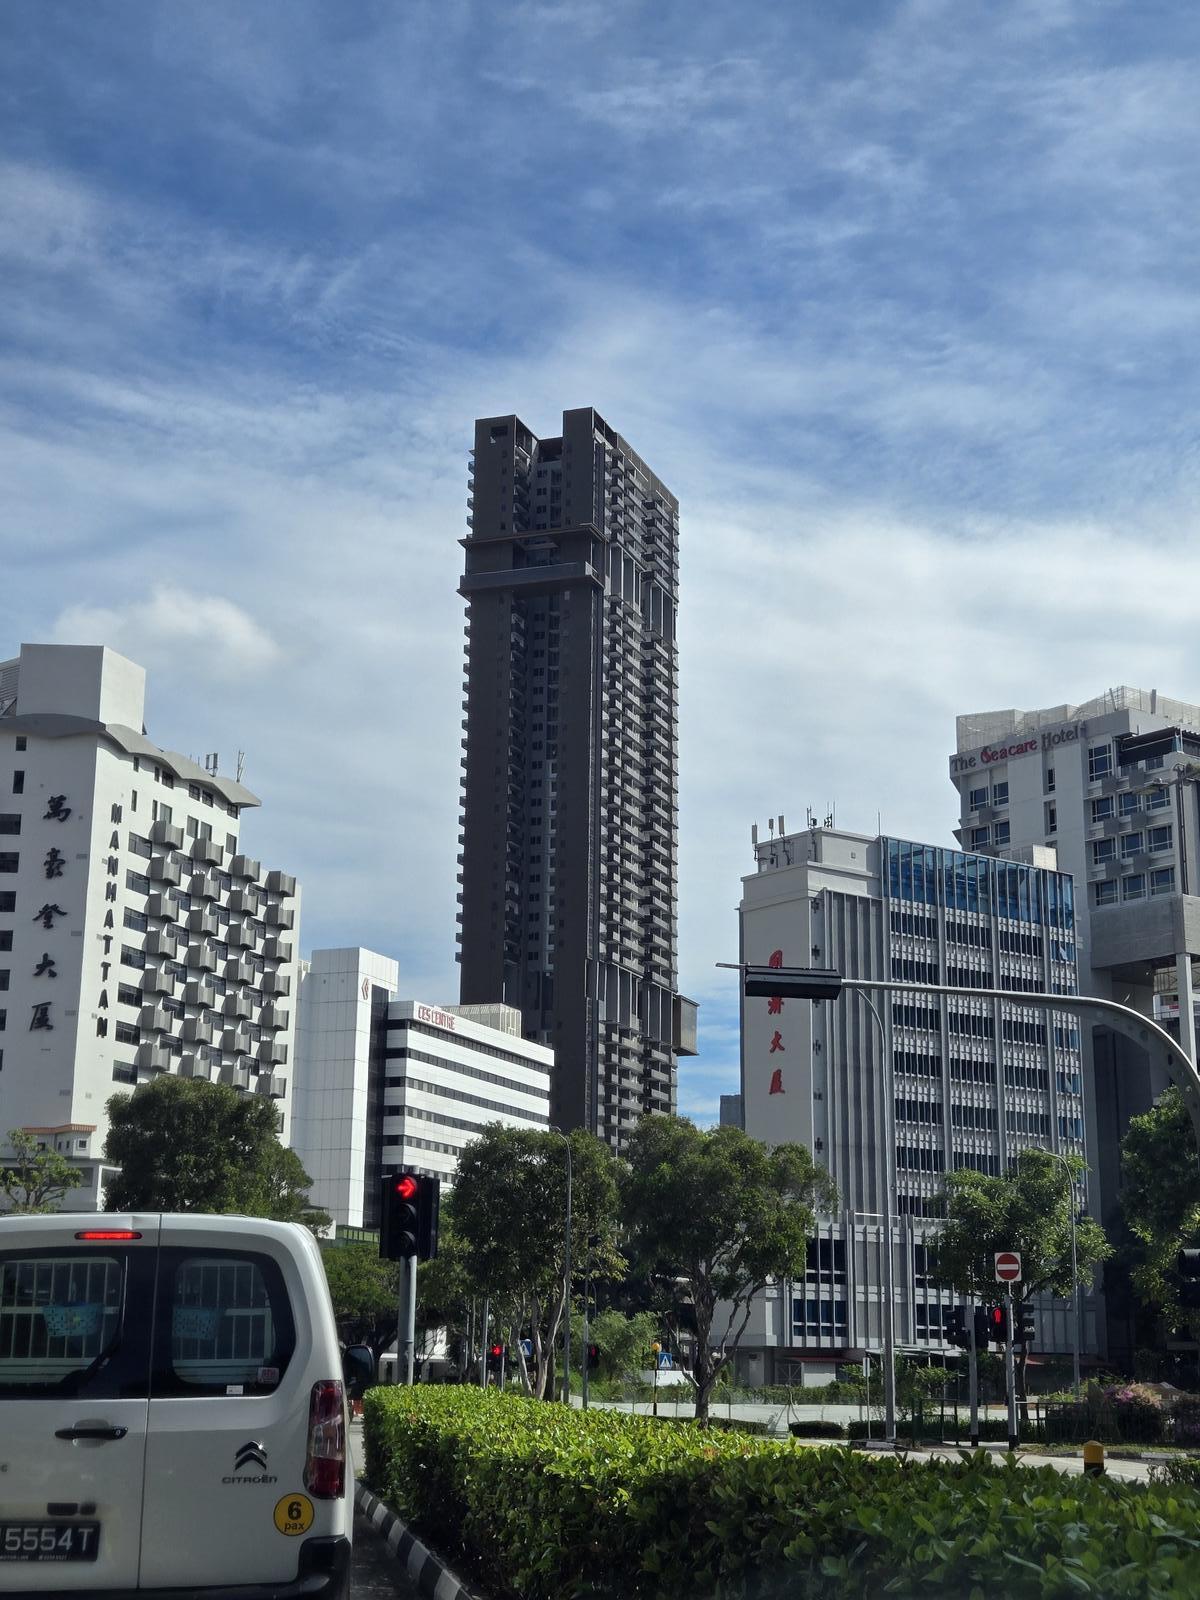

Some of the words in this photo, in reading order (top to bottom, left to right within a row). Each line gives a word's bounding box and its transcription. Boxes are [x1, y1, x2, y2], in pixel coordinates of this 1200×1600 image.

[952, 756, 977, 772] The
[980, 738, 1038, 764] Seacare
[1041, 725, 1079, 748] Hotel
[96, 803, 123, 1039] MANHATTAN
[418, 1005, 431, 1022] CES
[431, 1010, 456, 1031] CENTRE
[287, 1501, 302, 1520] 6
[284, 1522, 305, 1532] pax
